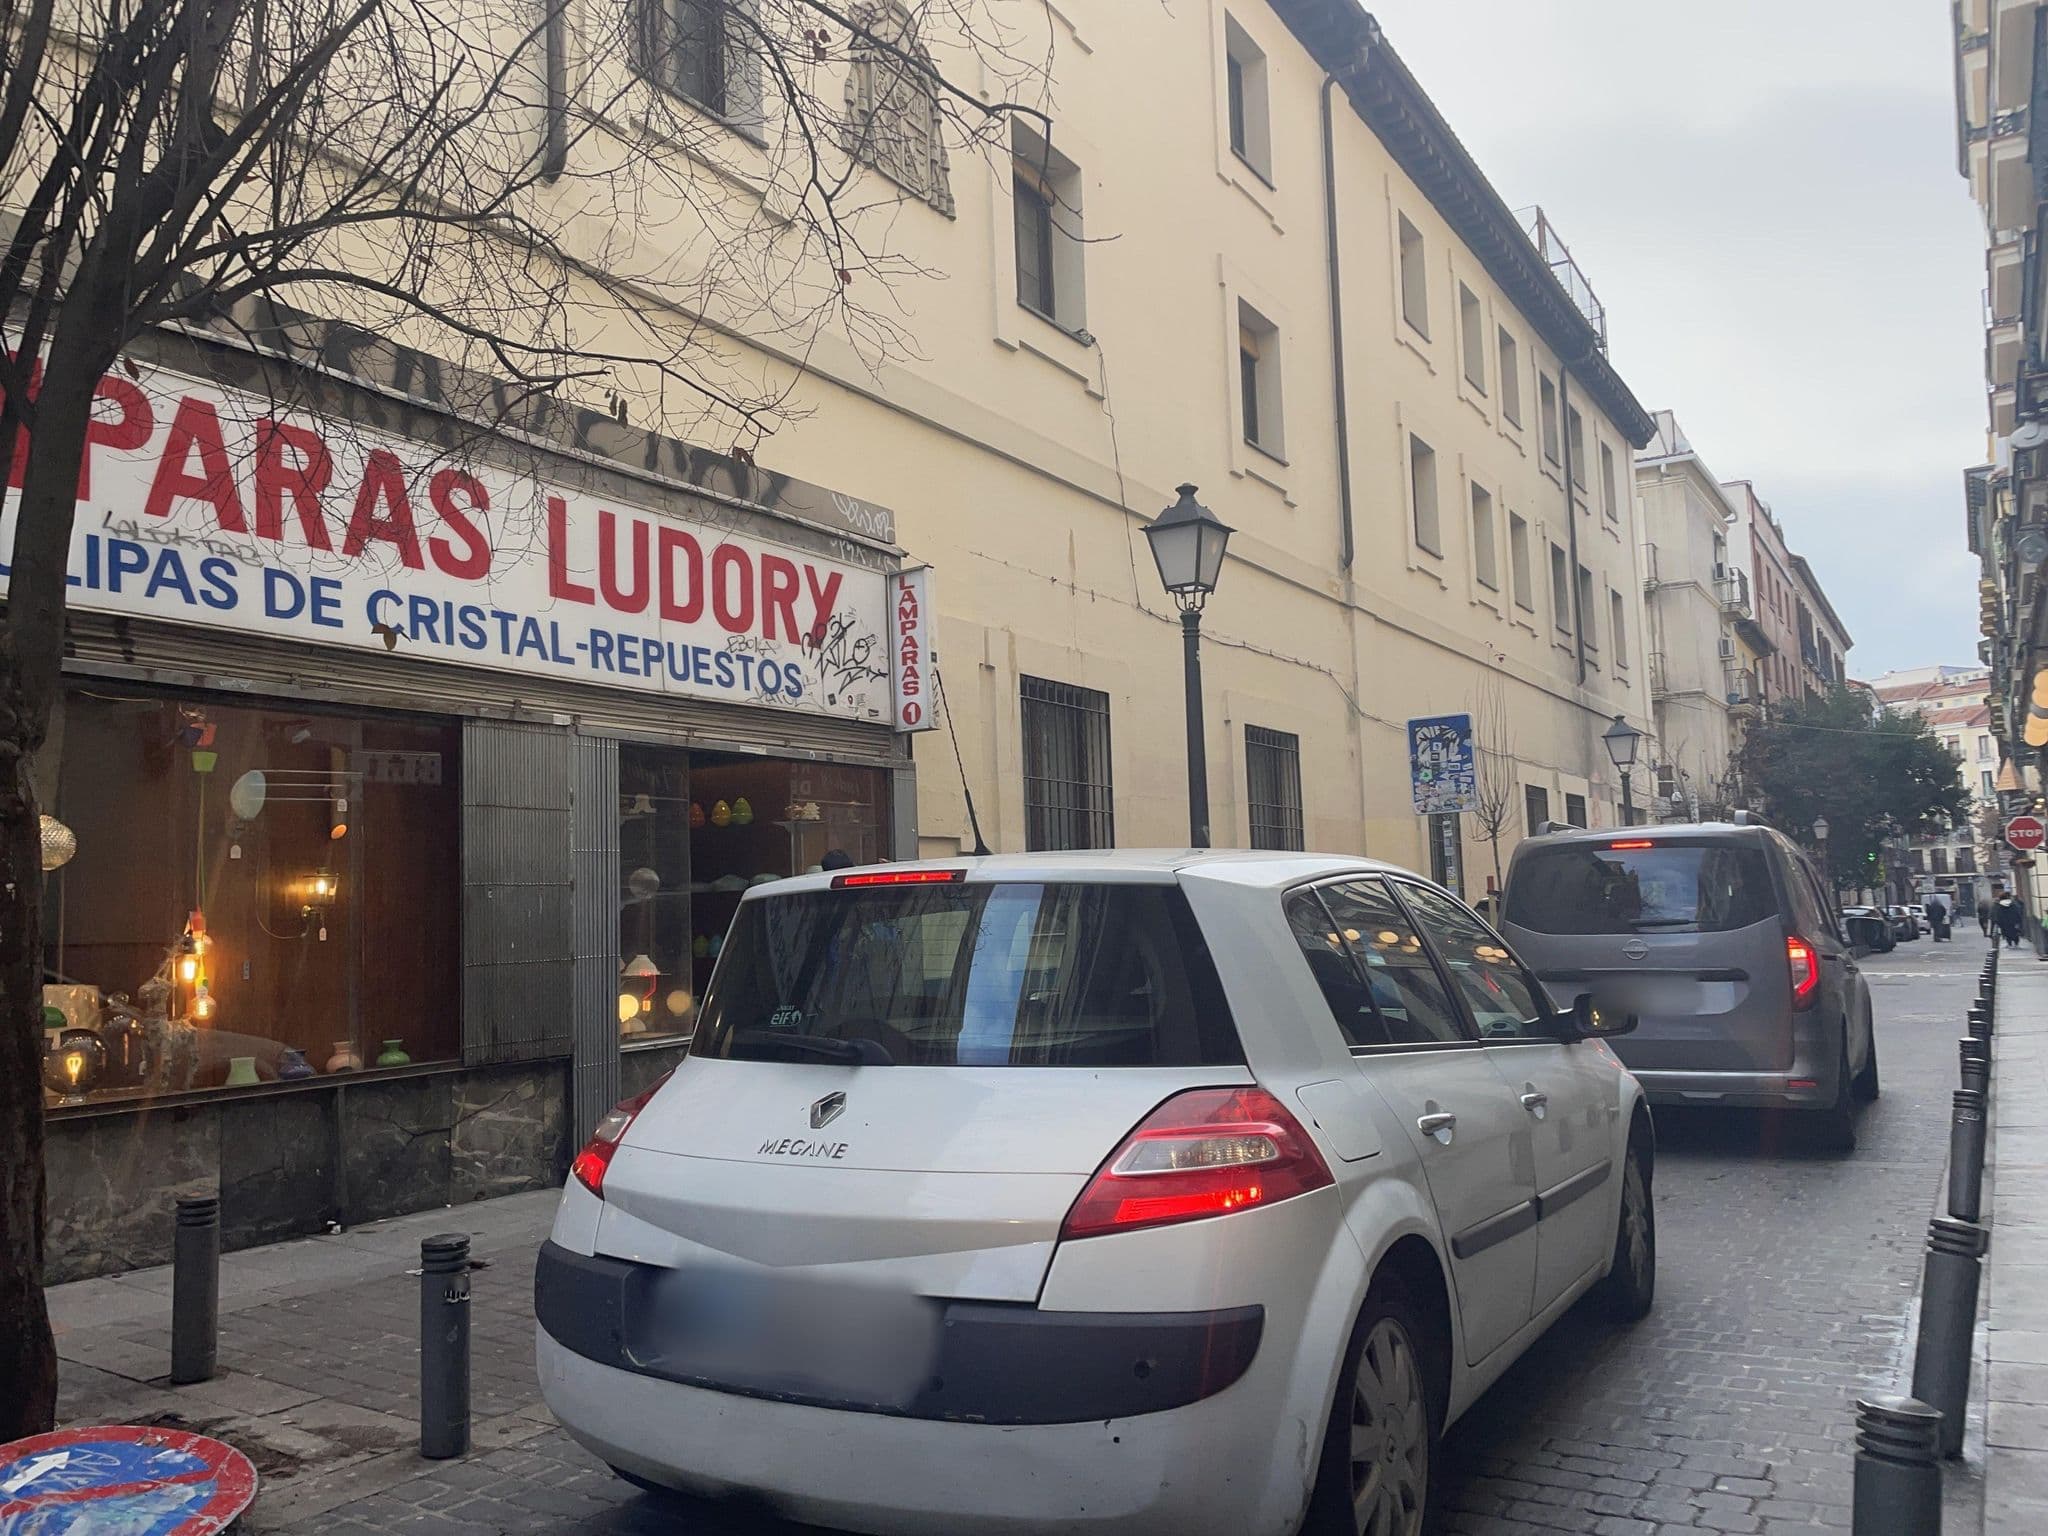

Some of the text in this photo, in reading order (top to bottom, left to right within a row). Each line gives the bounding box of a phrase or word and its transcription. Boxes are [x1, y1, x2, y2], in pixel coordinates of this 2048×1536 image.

[264, 568, 344, 629] DE
[366, 589, 802, 697] CRISTAL-REPUESTOS
[547, 496, 844, 650] LUDORY
[898, 575, 920, 697] LAMPARAS
[2009, 829, 2043, 837] STOP
[757, 1138, 849, 1160] MEGANE
